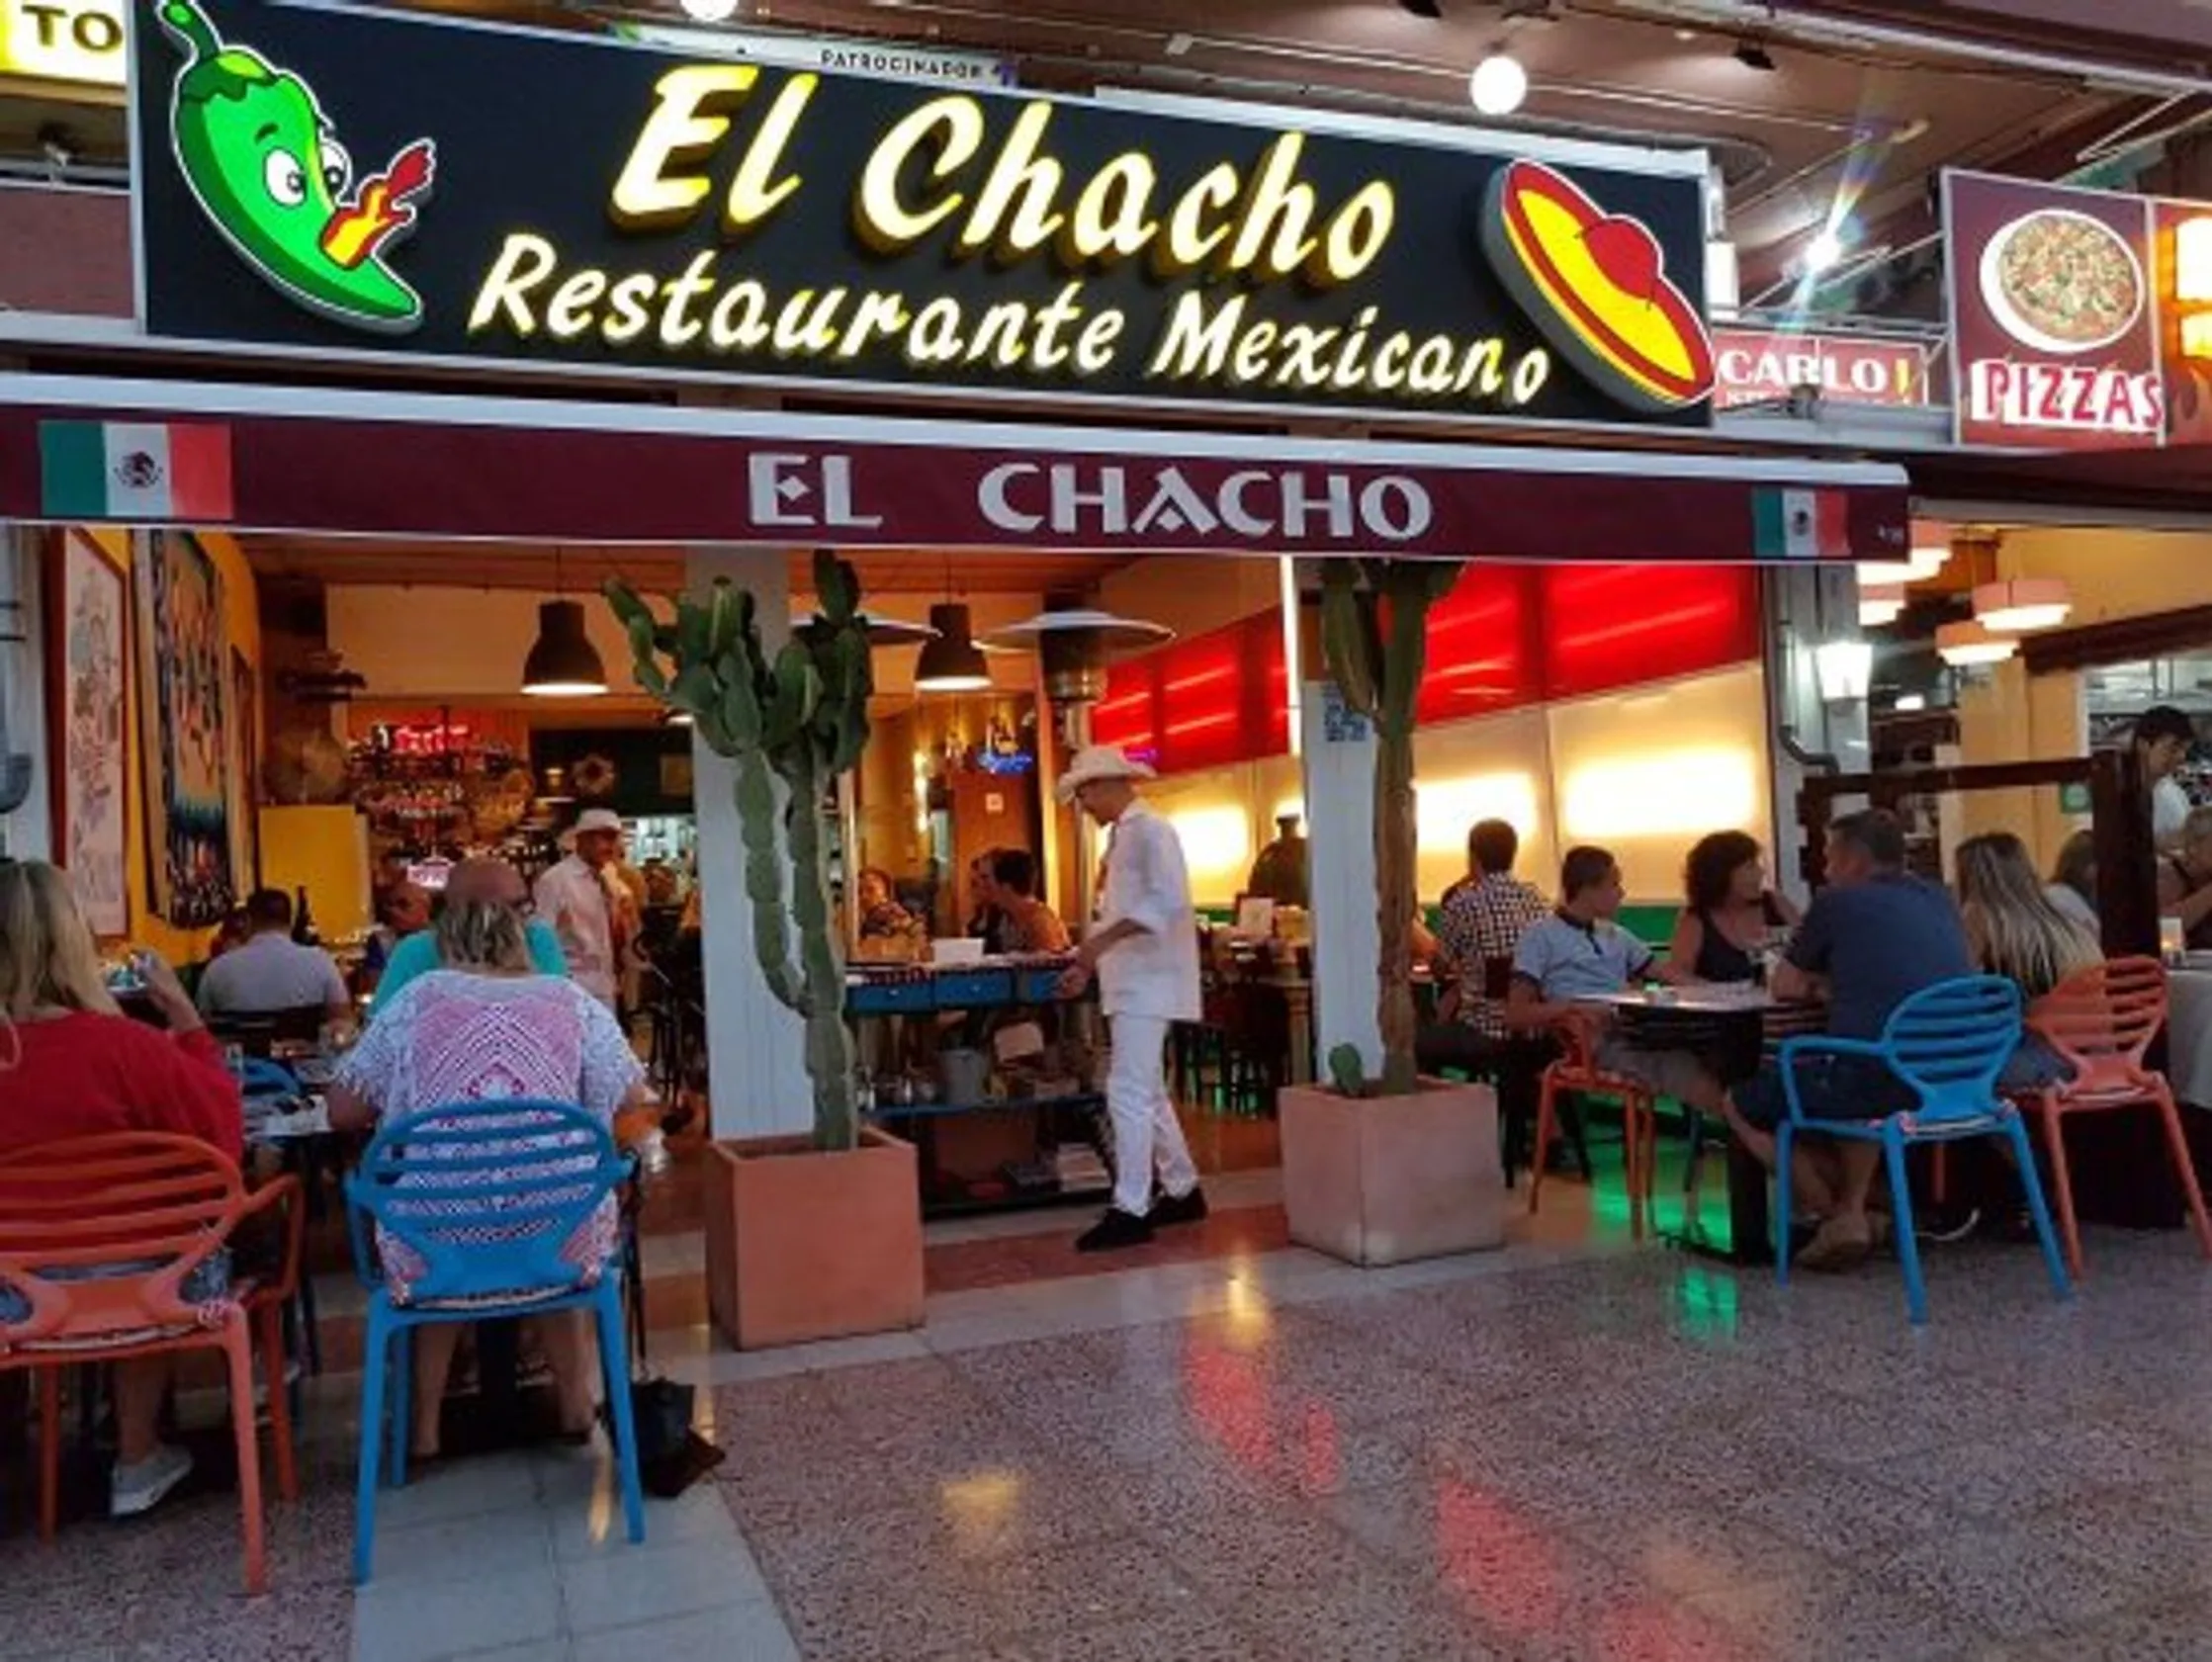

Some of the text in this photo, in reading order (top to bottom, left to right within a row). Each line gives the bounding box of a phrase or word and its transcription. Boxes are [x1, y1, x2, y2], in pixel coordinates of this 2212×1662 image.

[21, 4, 124, 51] TO
[611, 63, 1395, 283] El Chacho
[467, 232, 1549, 405] Restaurante Mexicano
[1978, 360, 2164, 429] PIZZAS
[748, 452, 1434, 542] EL CHACHO
